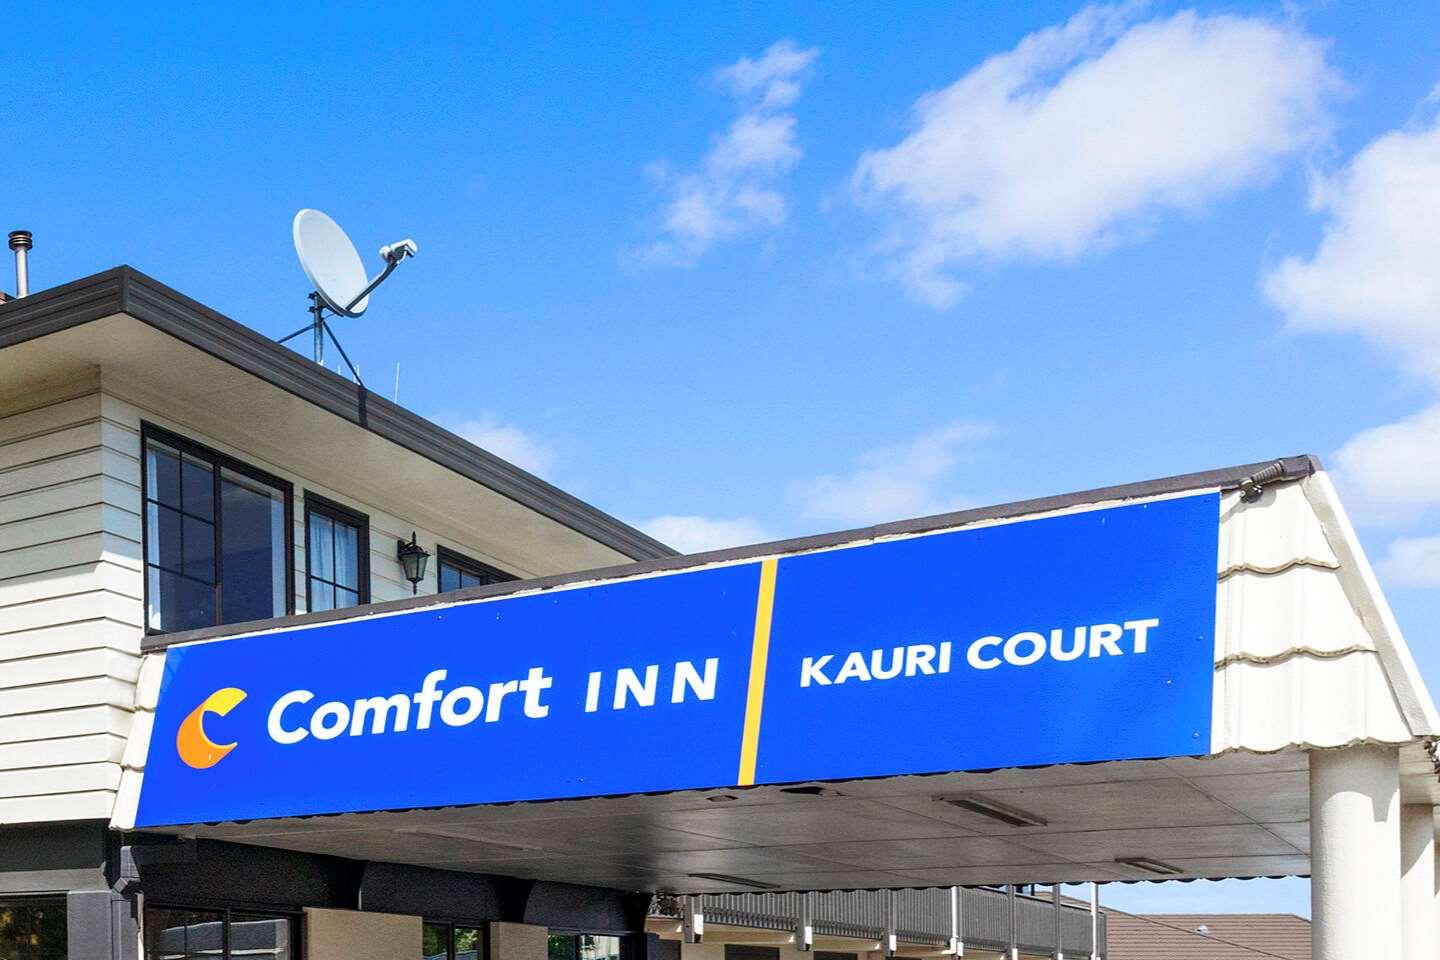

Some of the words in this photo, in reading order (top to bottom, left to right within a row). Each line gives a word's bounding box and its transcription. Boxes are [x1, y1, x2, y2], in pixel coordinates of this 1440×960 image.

[799, 641, 952, 688] KAURI
[966, 618, 1160, 670] COURT
[267, 666, 553, 745] Comfort
[584, 657, 719, 713] INN
